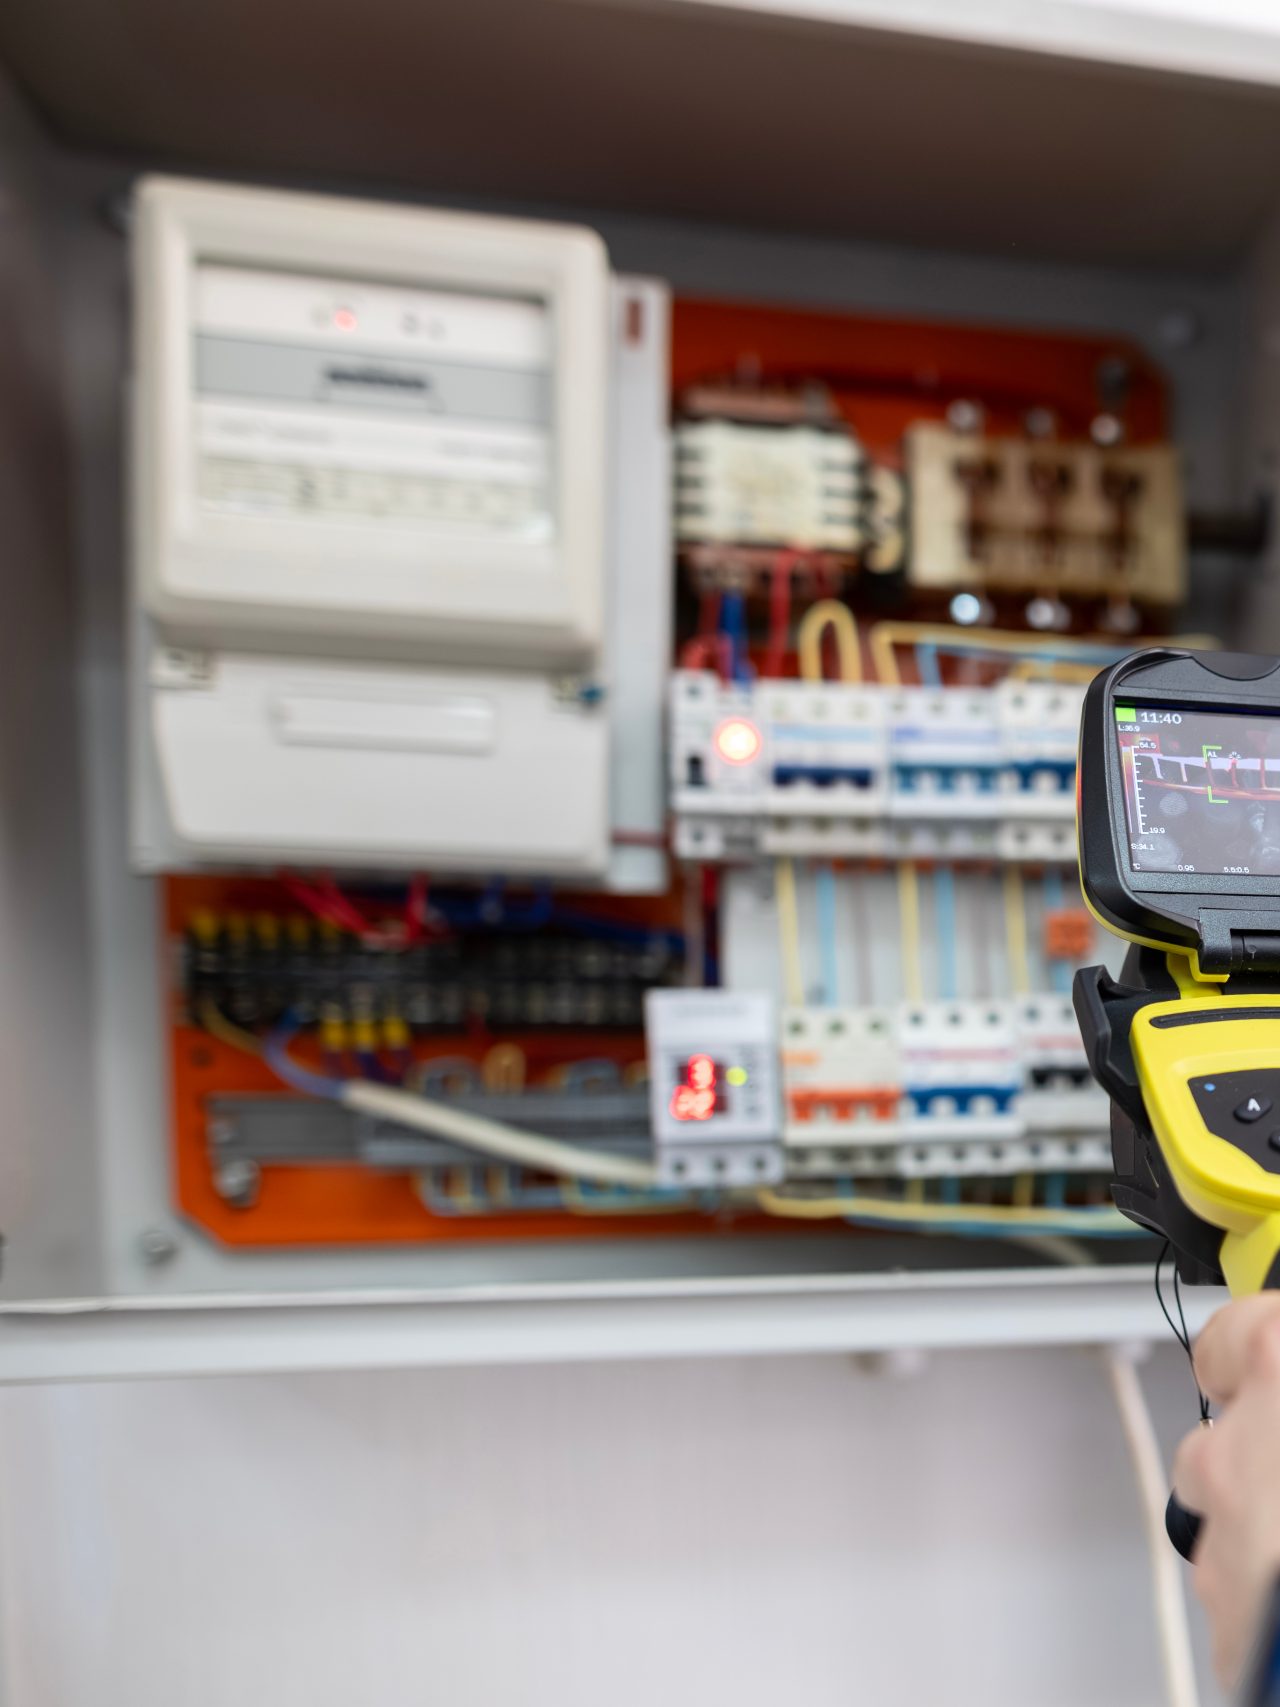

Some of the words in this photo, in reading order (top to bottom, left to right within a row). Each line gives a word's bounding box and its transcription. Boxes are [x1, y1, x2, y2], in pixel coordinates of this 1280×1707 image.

[1140, 712, 1182, 724] 11:40
[1207, 750, 1217, 758] A1
[1177, 864, 1195, 872] 0.95
[1247, 1097, 1261, 1112] A
